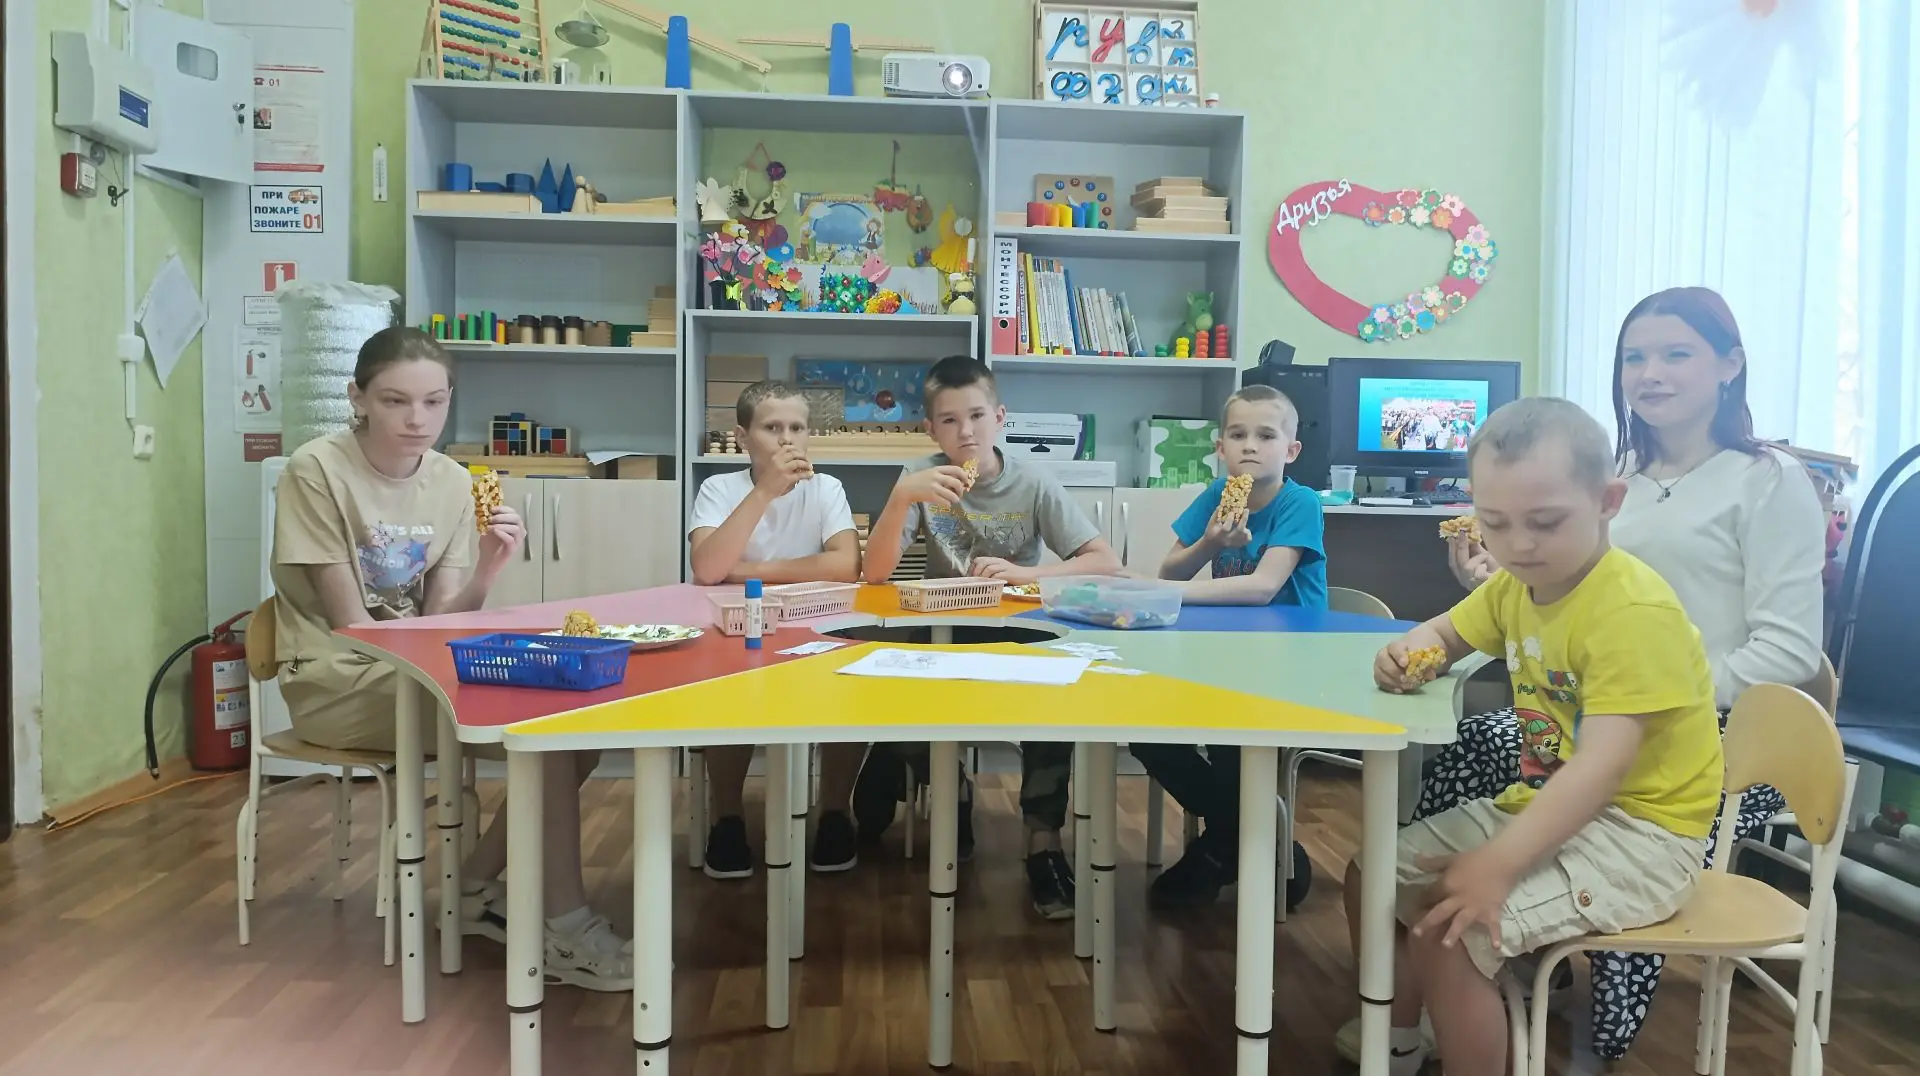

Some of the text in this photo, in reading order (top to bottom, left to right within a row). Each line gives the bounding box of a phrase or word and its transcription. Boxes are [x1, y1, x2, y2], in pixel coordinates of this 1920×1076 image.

[268, 78, 280, 87] 01
[262, 191, 283, 199] ПРИ
[254, 205, 301, 215] ПОЖАРЕ
[1276, 177, 1352, 236] Друзья
[254, 213, 322, 230] ЗВОНИТЕ 01
[999, 241, 1013, 315] МОНТЕССОРИ
